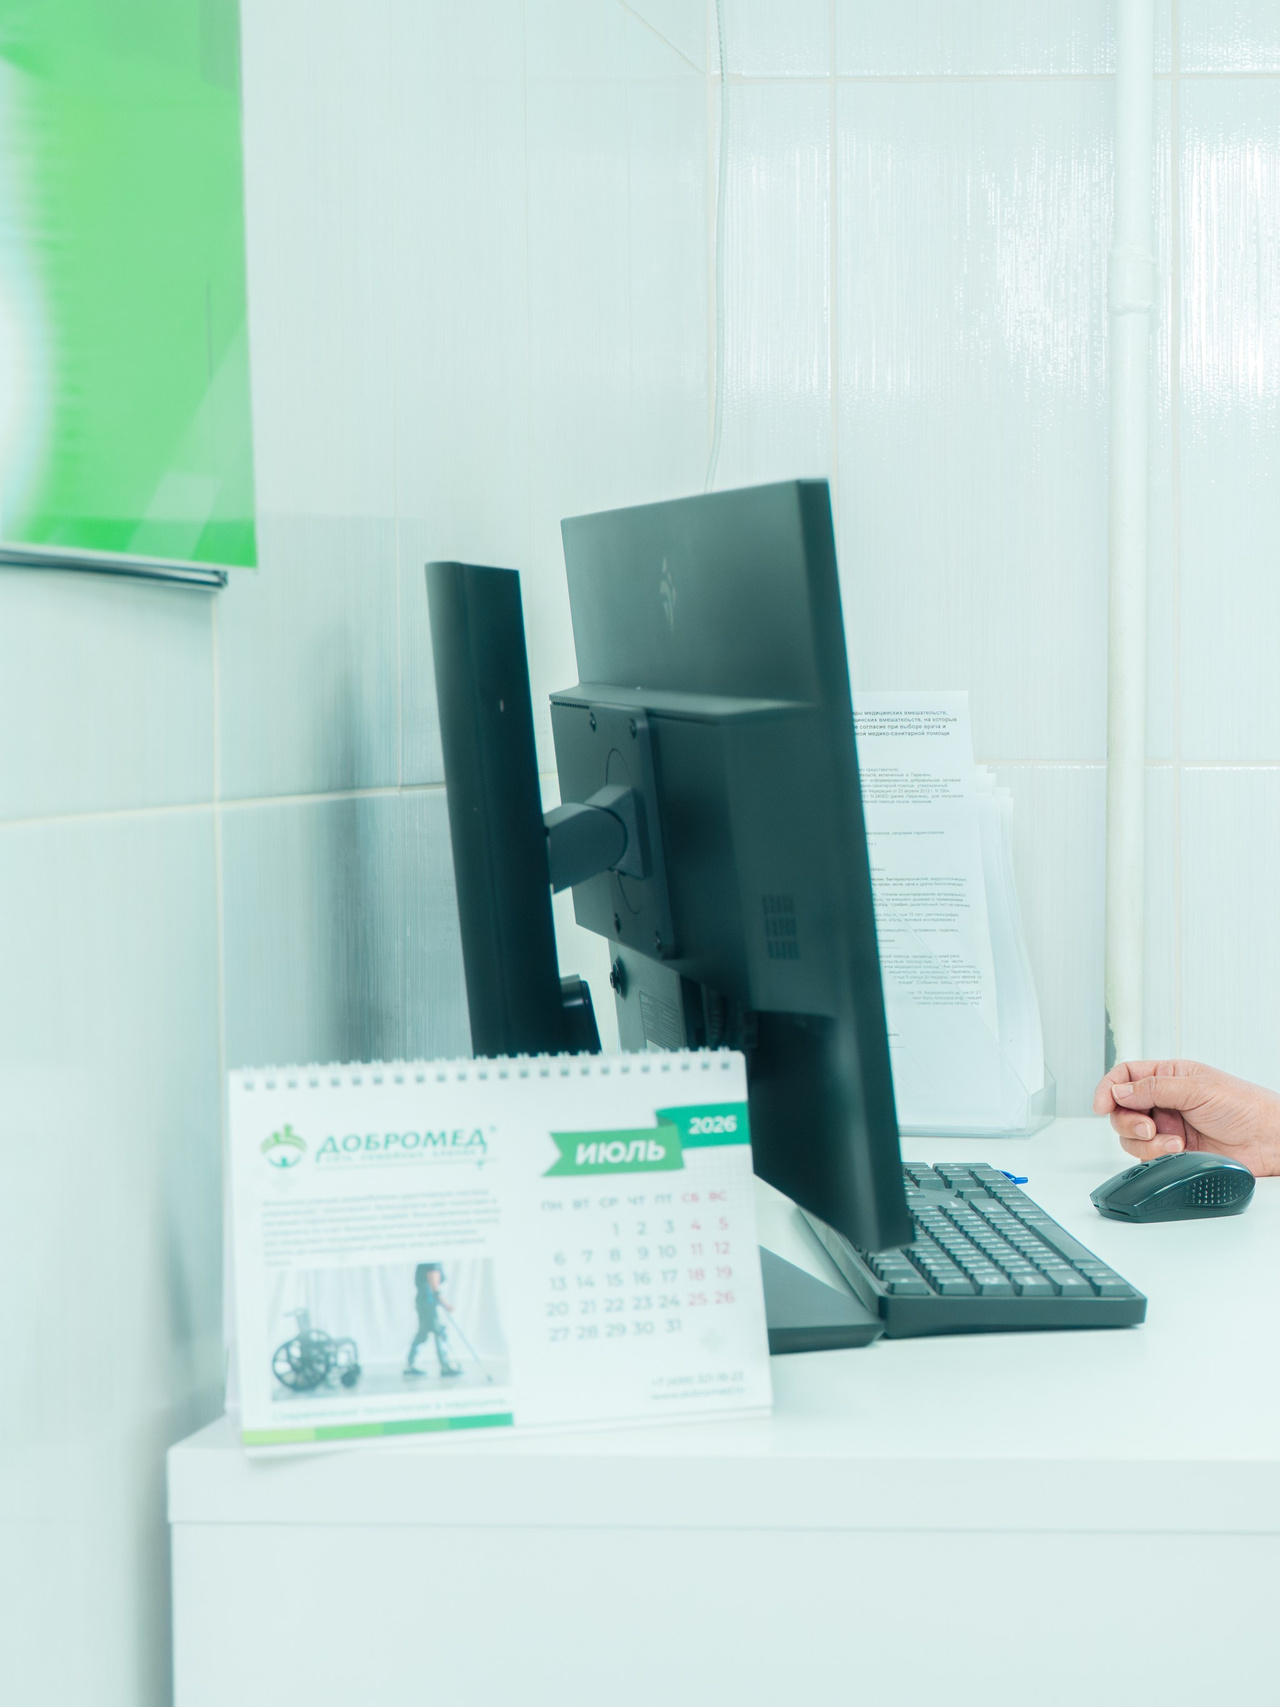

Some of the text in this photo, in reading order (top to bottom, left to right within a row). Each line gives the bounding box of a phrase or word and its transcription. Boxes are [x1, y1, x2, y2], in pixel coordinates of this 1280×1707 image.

[688, 1115, 737, 1135] 2026
[315, 1128, 487, 1163] ДОБРОМЕД
[575, 1139, 667, 1166] ИЮЛЬ
[541, 1191, 727, 1211] ПН ВТ СР ЧТ ПТ СБ ВС
[612, 1216, 729, 1237] 1 2 3 4 5
[553, 1241, 730, 1266] 6 7 8 9 10 11 12
[550, 1265, 732, 1291] 13 14 15 16 17 18 19
[546, 1290, 735, 1317] 20 21 22 23 24 25 26
[549, 1318, 682, 1342] 27 28 29 30 31
